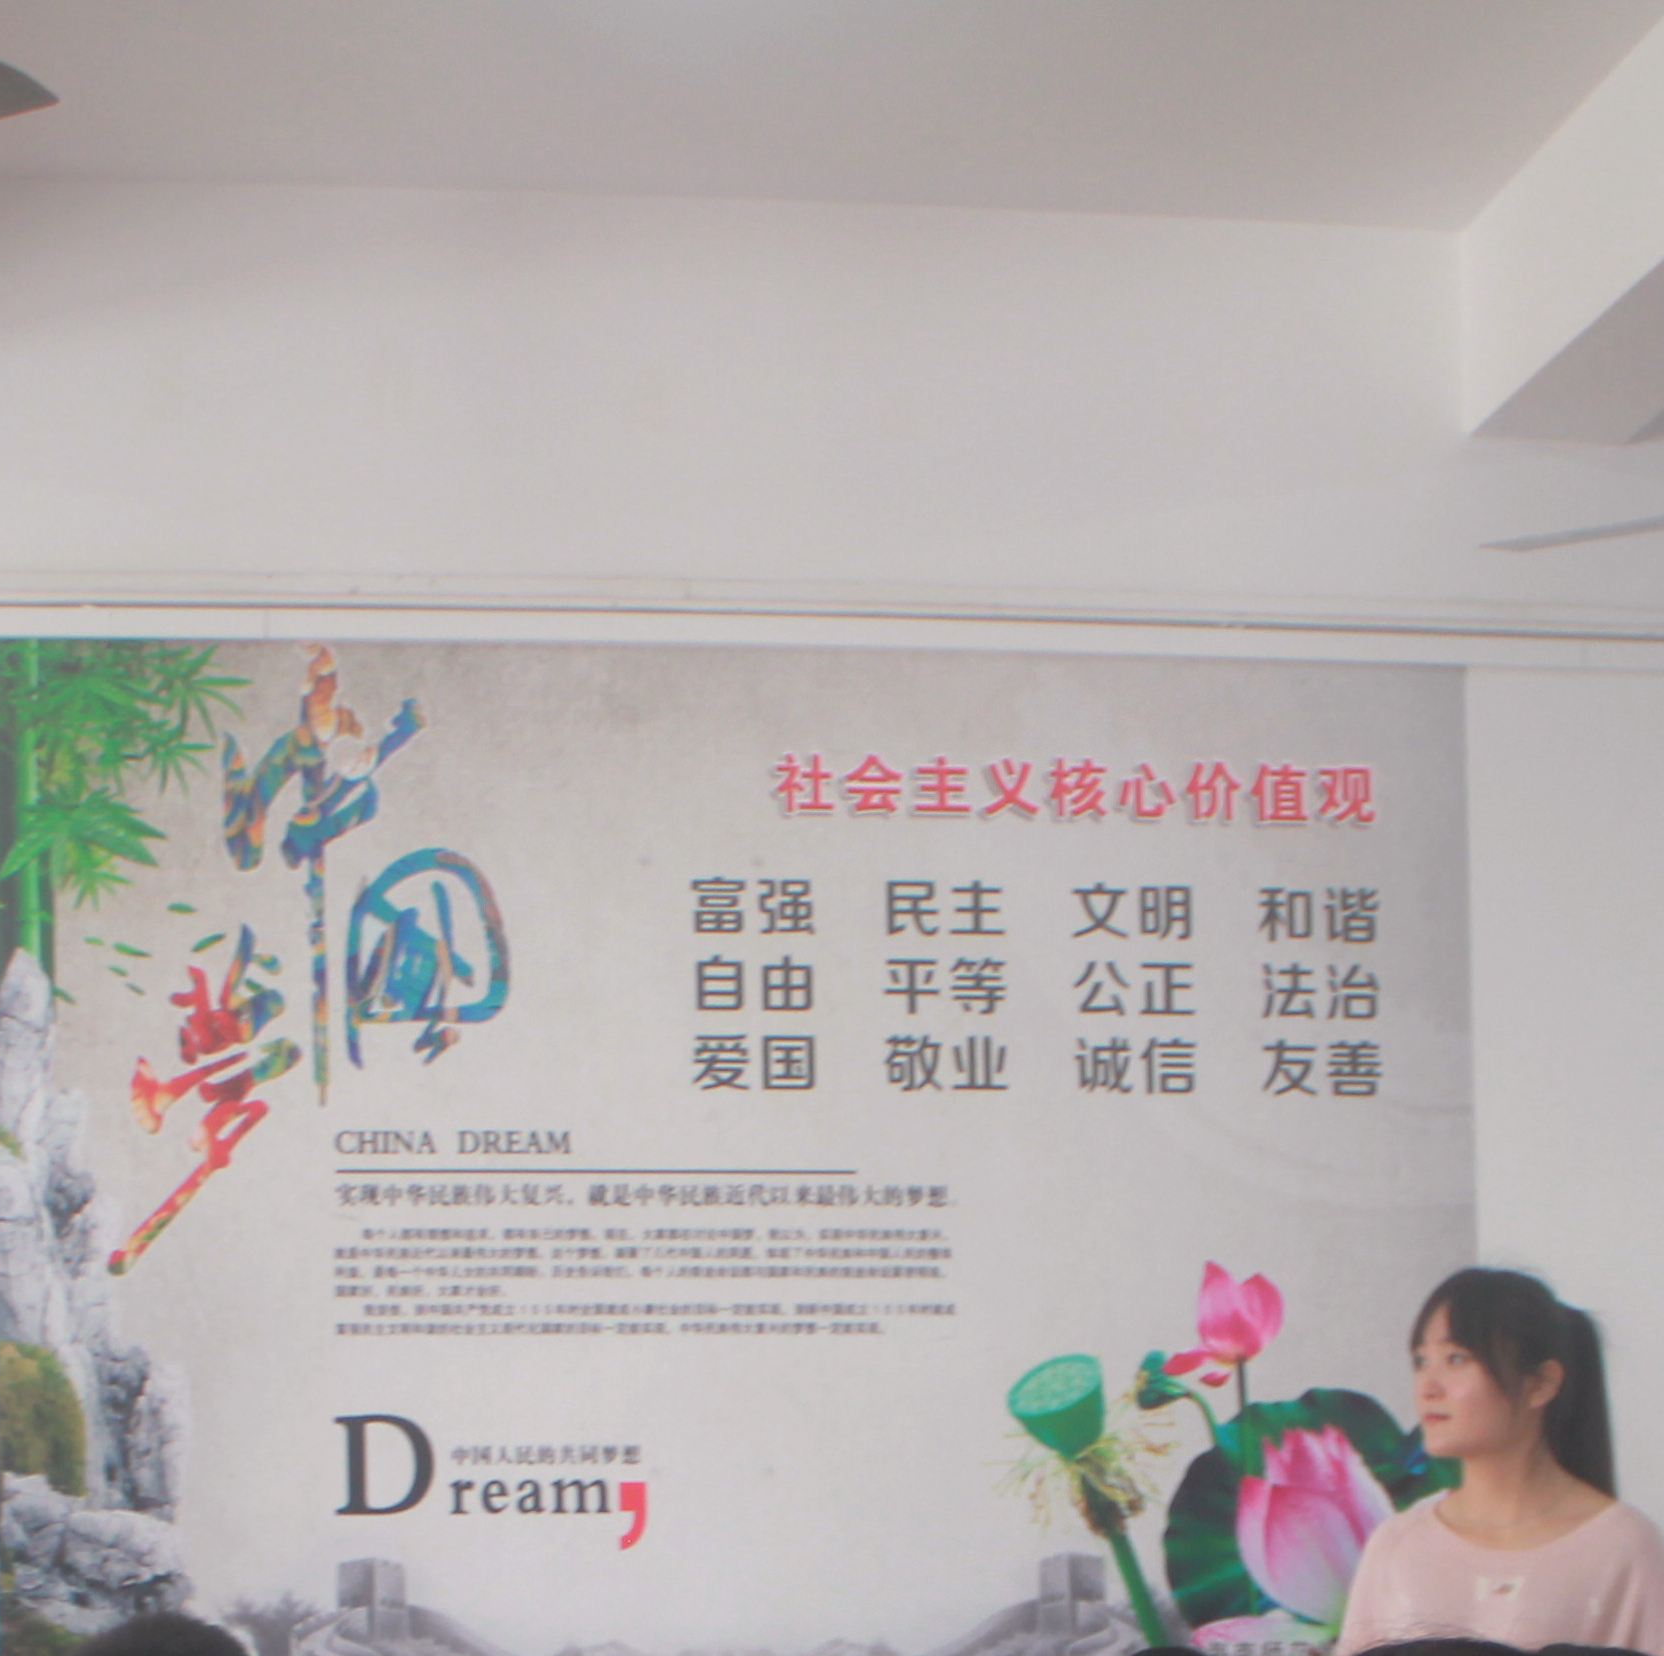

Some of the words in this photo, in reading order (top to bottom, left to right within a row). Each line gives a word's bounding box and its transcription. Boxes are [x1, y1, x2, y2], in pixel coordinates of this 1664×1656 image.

[774, 754, 1378, 826] 社会主义核心价值观
[691, 876, 815, 936] 富强
[885, 879, 1006, 938] 民主
[1072, 881, 1193, 942] 文明
[1259, 886, 1379, 945] 和谐
[694, 954, 814, 1013] 自由
[883, 957, 1007, 1016] 平等
[1073, 960, 1196, 1018] 公正
[1262, 962, 1380, 1021] 法治
[692, 1034, 815, 1091] 爱国
[884, 1035, 1008, 1093] 敬业
[1075, 1038, 1196, 1095] 诚信
[1262, 1040, 1382, 1098] 友善
[334, 1130, 437, 1155] CHINA
[458, 1130, 572, 1155] DREAM
